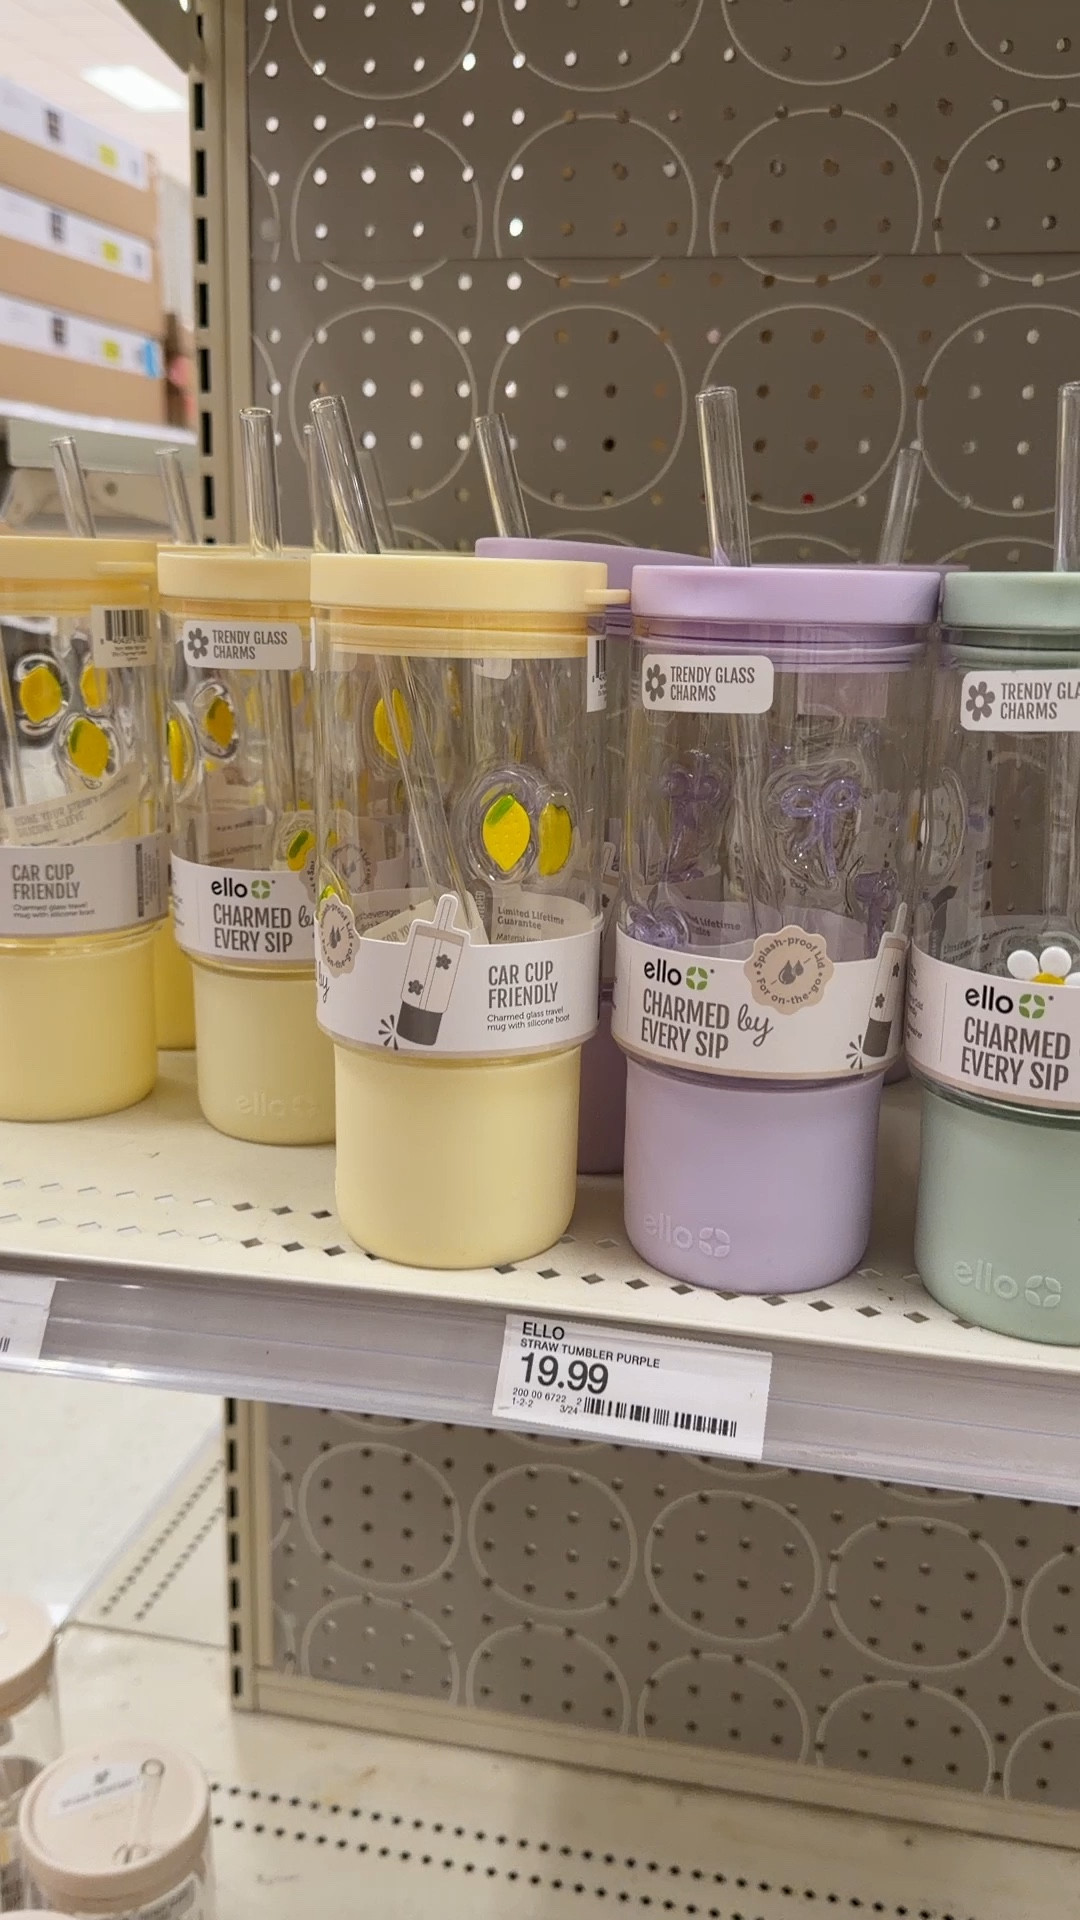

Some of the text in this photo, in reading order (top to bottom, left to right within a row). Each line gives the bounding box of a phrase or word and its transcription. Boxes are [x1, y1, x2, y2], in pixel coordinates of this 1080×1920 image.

[212, 629, 288, 646] TRENDY GLASS
[213, 646, 256, 660] CHARMS
[670, 666, 755, 684] TRENDY GLASS
[670, 684, 716, 701] CHARMS
[1001, 681, 1080, 700] TRENDY GLA
[1000, 702, 1058, 720] CHARMS
[12, 863, 75, 882] CAR CUP
[13, 881, 81, 900] FRIENDLY
[211, 877, 248, 898] ello
[213, 903, 292, 929] CHARMED
[497, 906, 565, 925] Limited Lifetime
[497, 916, 542, 930] Guarantee
[214, 927, 293, 953] EVERY SIP
[753, 937, 826, 969] Splash-proof Lid
[488, 960, 554, 986] CAR CUP
[643, 958, 682, 986] ello
[488, 981, 559, 1009] FRIENDLY
[757, 977, 821, 1005] For on-the-go
[965, 984, 1014, 1014] ello
[487, 1006, 564, 1022] Charmed glass travel
[487, 1014, 570, 1032] mug with silicone boot
[643, 987, 774, 1047] CHARMED by
[641, 1016, 729, 1059] EVERY SIP
[963, 1016, 1071, 1060] CHARMED
[961, 1046, 1069, 1092] EVERY SIP
[643, 1212, 693, 1249] ello
[953, 1258, 1018, 1300] ello
[522, 1321, 565, 1341] ELLO
[520, 1337, 661, 1369] STRAW TUMBLER PURPLE
[521, 1351, 609, 1395] 19.99
[512, 1387, 582, 1406] 200 00 6722 2
[512, 1397, 578, 1415] 1-2-2 3/24
